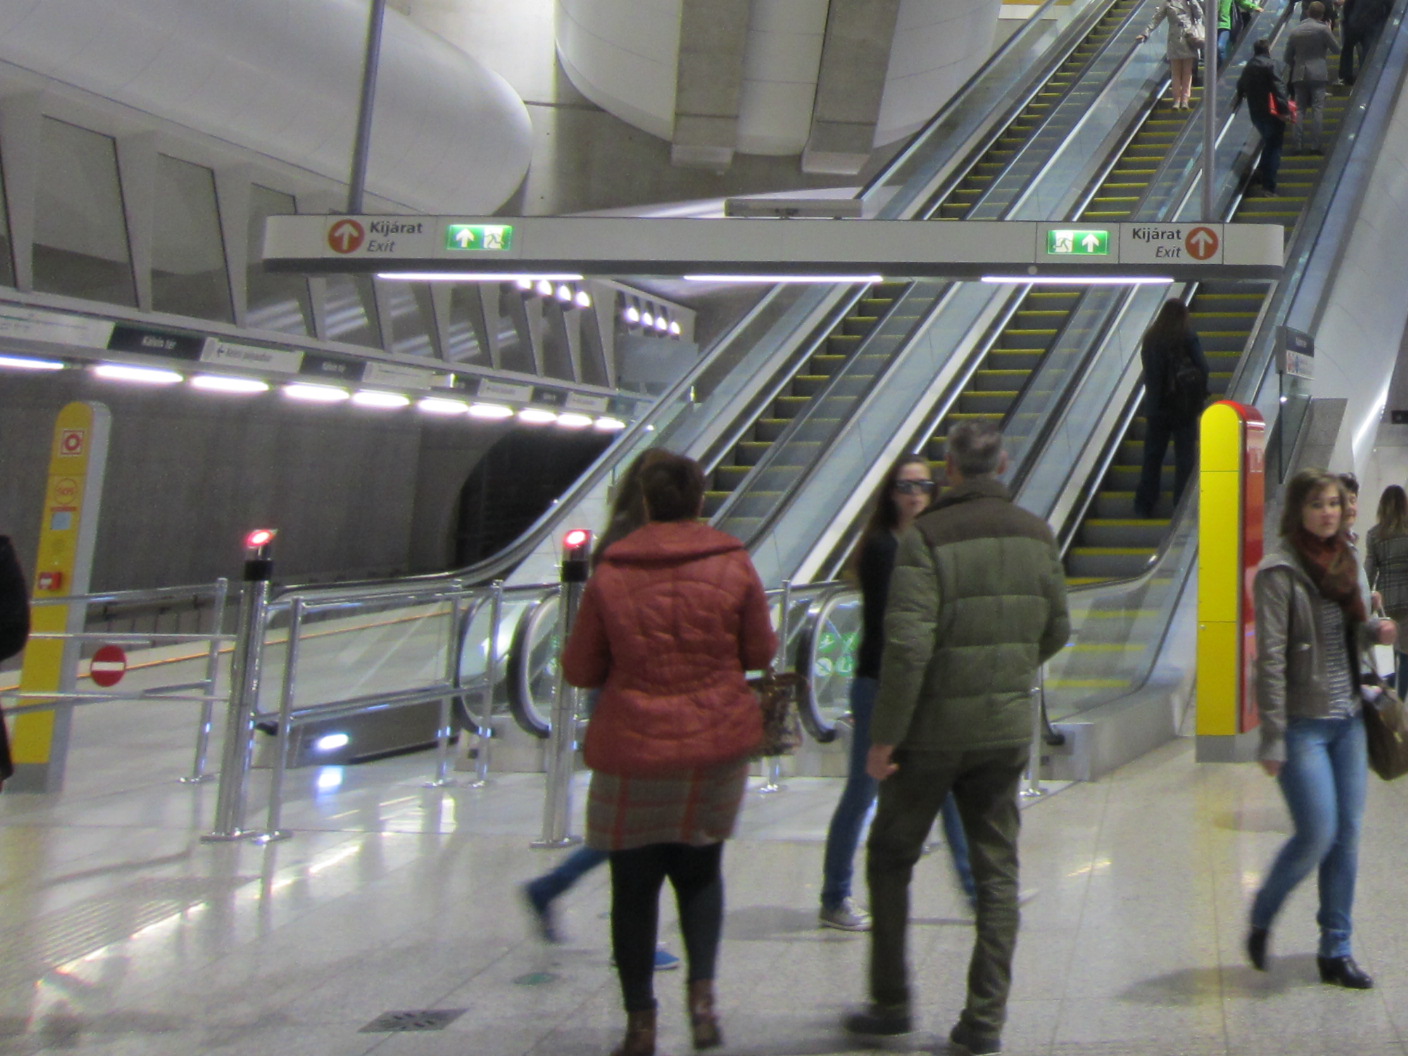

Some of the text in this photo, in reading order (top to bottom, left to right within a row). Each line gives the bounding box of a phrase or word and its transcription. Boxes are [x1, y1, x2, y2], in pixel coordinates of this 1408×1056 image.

[369, 220, 424, 237] Kijárat
[1131, 227, 1183, 243] Kijárat
[366, 239, 396, 253] Exit
[1155, 245, 1182, 259] Exit
